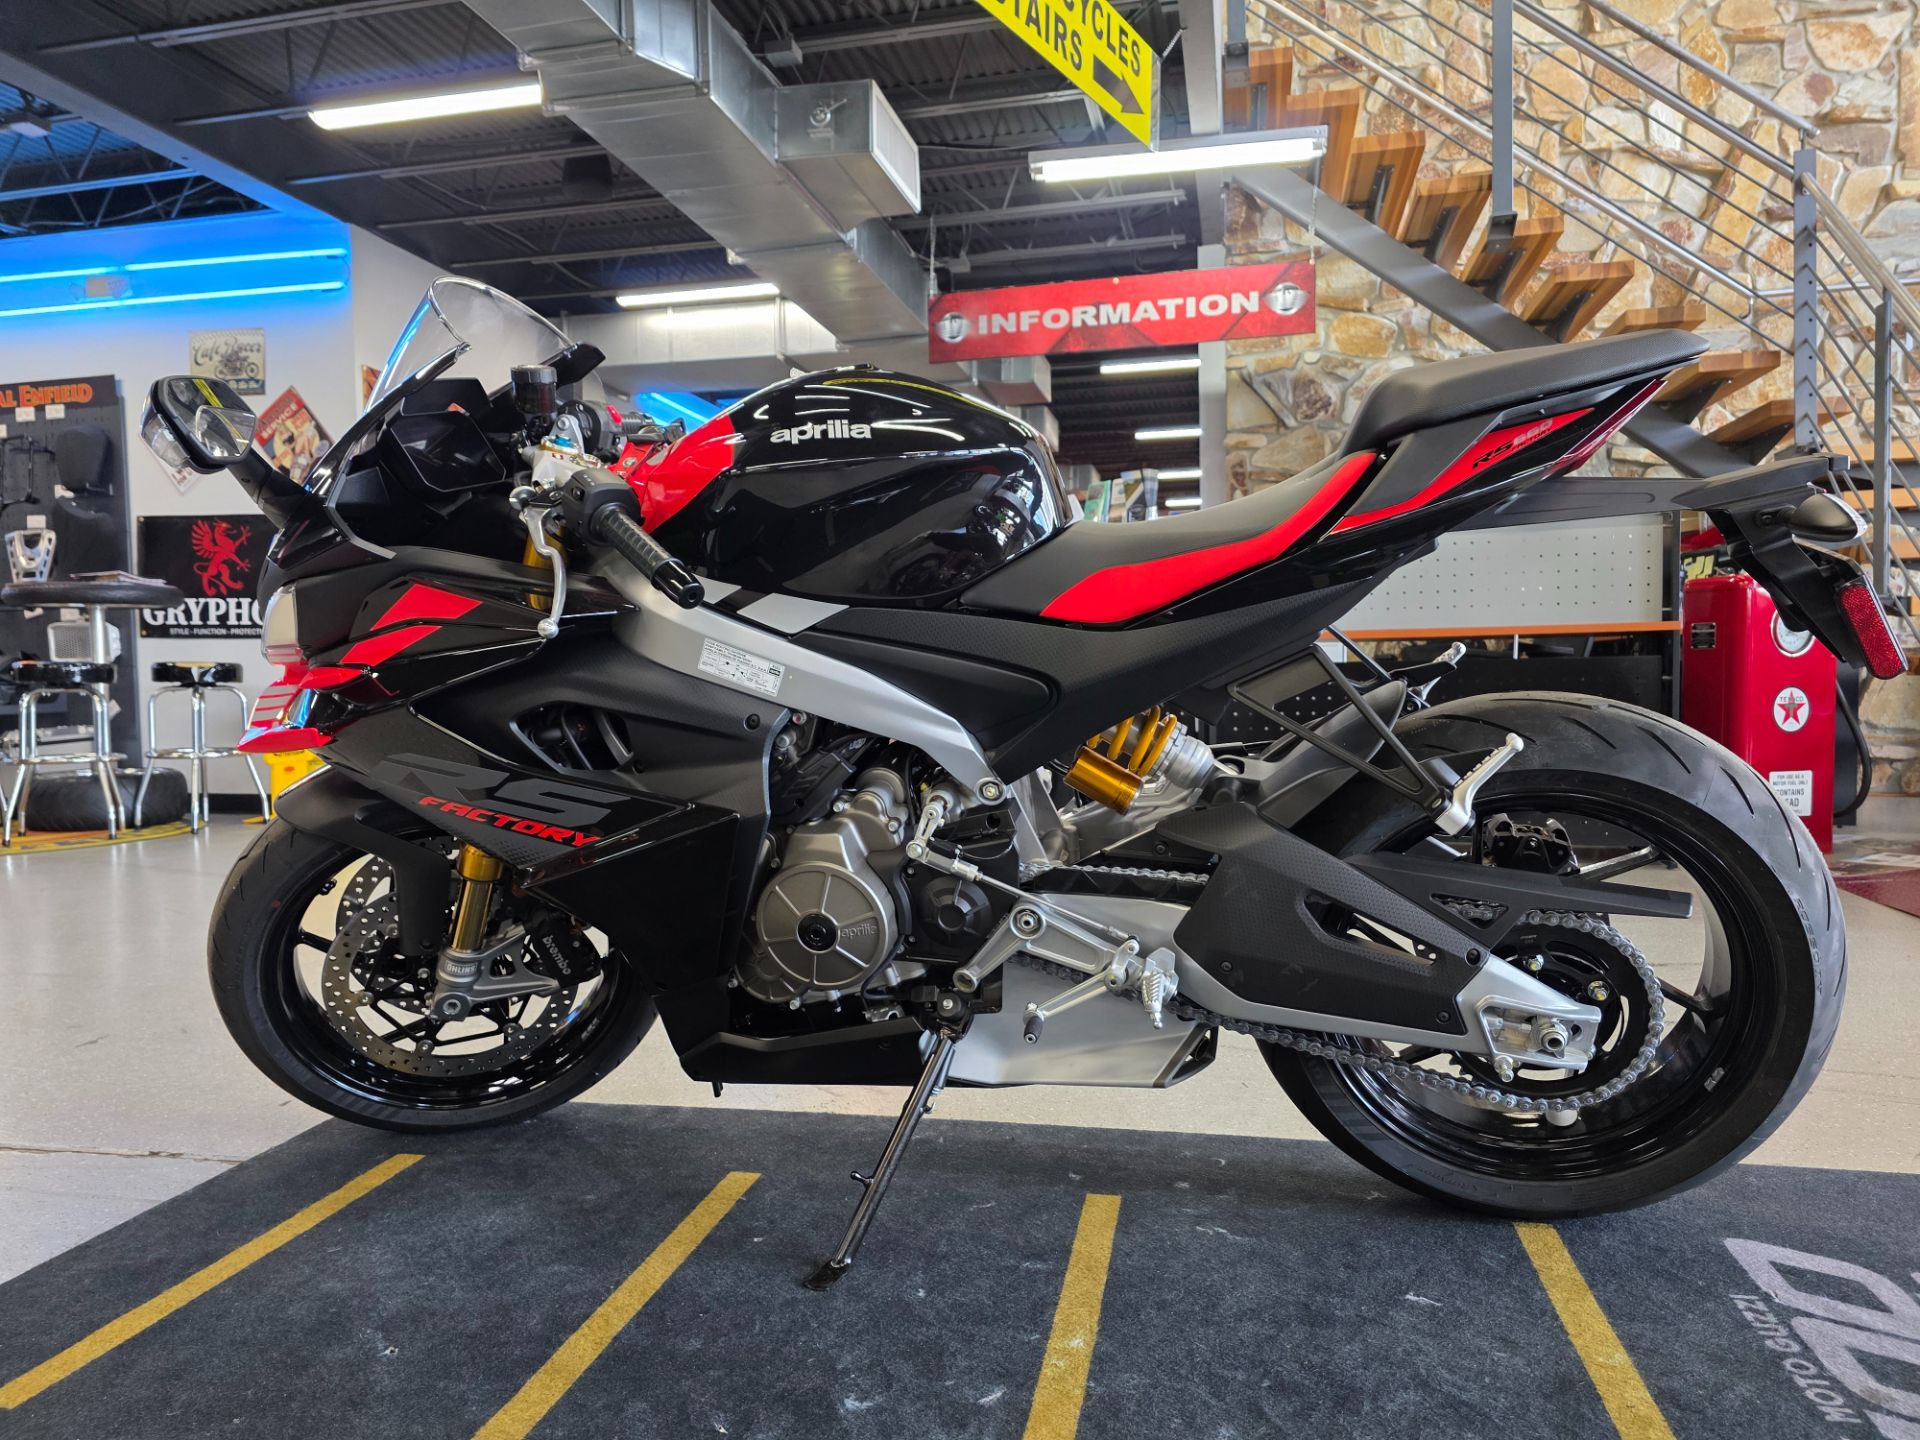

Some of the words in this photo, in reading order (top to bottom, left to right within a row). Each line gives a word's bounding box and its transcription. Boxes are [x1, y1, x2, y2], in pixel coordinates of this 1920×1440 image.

[978, 290, 1260, 335] INFORMATION
[769, 418, 872, 445] aprilia
[1472, 441, 1514, 470] RS
[369, 752, 632, 829] RS
[1776, 788, 1805, 796] ONTAINS
[418, 796, 603, 847] FACTORY
[841, 922, 878, 939] aprilia
[542, 935, 572, 976] brembo
[1729, 1294, 1800, 1352] GUZZI
[1782, 1358, 1862, 1424] MOTO
